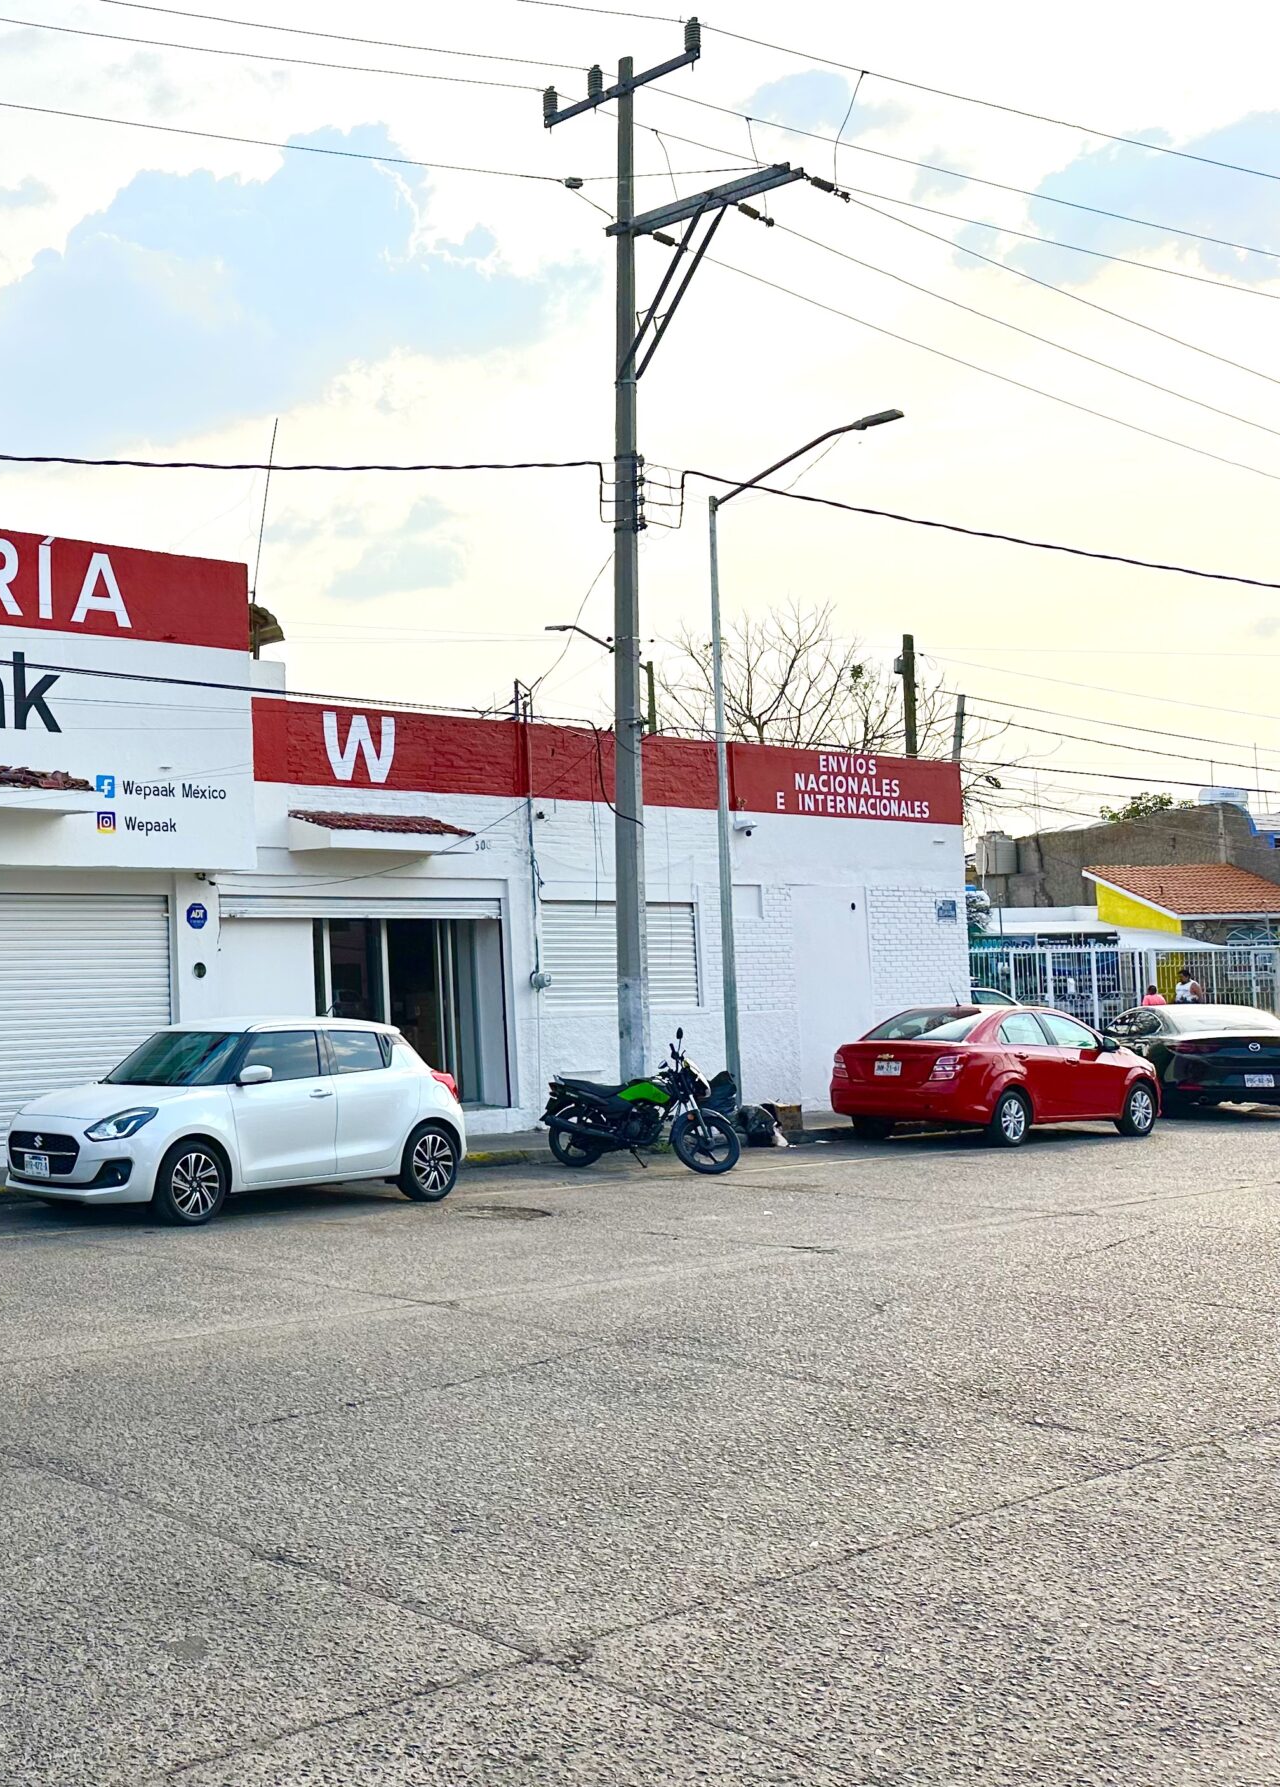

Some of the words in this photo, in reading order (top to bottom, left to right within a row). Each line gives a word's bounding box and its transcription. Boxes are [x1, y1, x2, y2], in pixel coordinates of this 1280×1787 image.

[323, 711, 395, 783] W
[819, 754, 877, 775] ENVÍOS
[122, 780, 176, 799] Wepaak
[182, 782, 227, 800] México
[794, 772, 900, 797] NACIONALES
[776, 791, 786, 809] E
[798, 793, 930, 818] INTERNACIONALES
[124, 816, 177, 836] Wepaak
[190, 909, 205, 918] ADT
